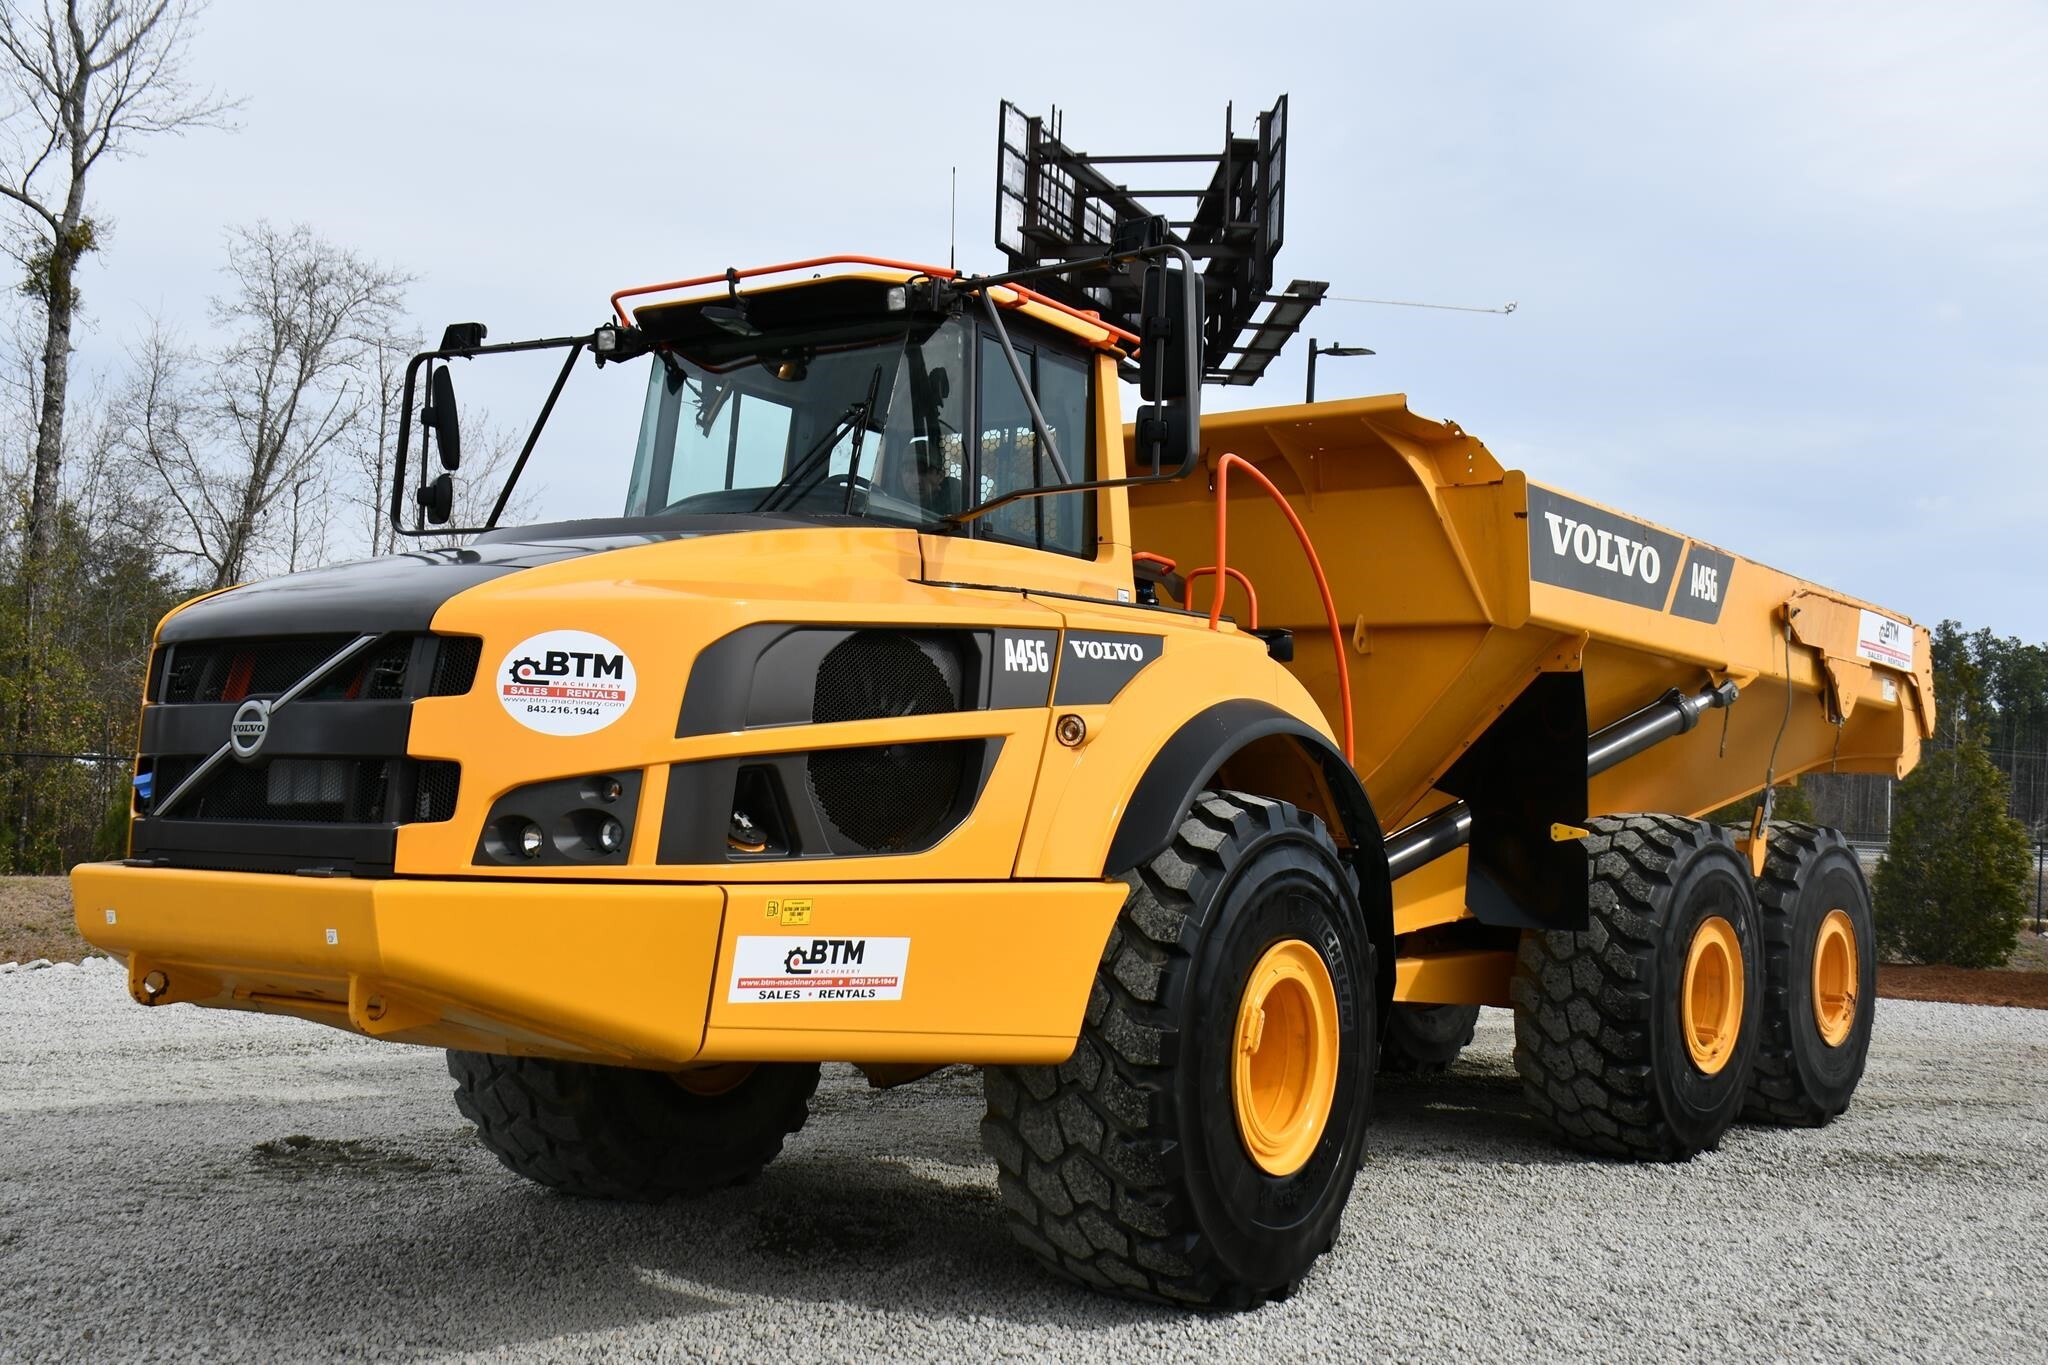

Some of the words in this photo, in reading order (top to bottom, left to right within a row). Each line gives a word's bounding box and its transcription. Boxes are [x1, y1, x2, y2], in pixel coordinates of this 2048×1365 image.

[1544, 511, 1661, 584] VOLVO
[1690, 562, 1718, 603] A45G
[1885, 621, 1899, 642] BTM
[1004, 638, 1049, 673] A45G
[1069, 640, 1144, 662] VOLVO
[546, 651, 624, 679] BTM
[510, 686, 548, 696] SALES
[566, 688, 619, 700] RENTALS
[553, 680, 621, 689] MACHINERY
[503, 697, 625, 708] www.btm-machinery.com
[527, 704, 600, 716] 843.216.1944
[810, 940, 866, 965] BTM
[740, 977, 833, 987] www.btm-machinery.com
[758, 989, 801, 1000] SALES
[818, 988, 876, 999] RENTALS
